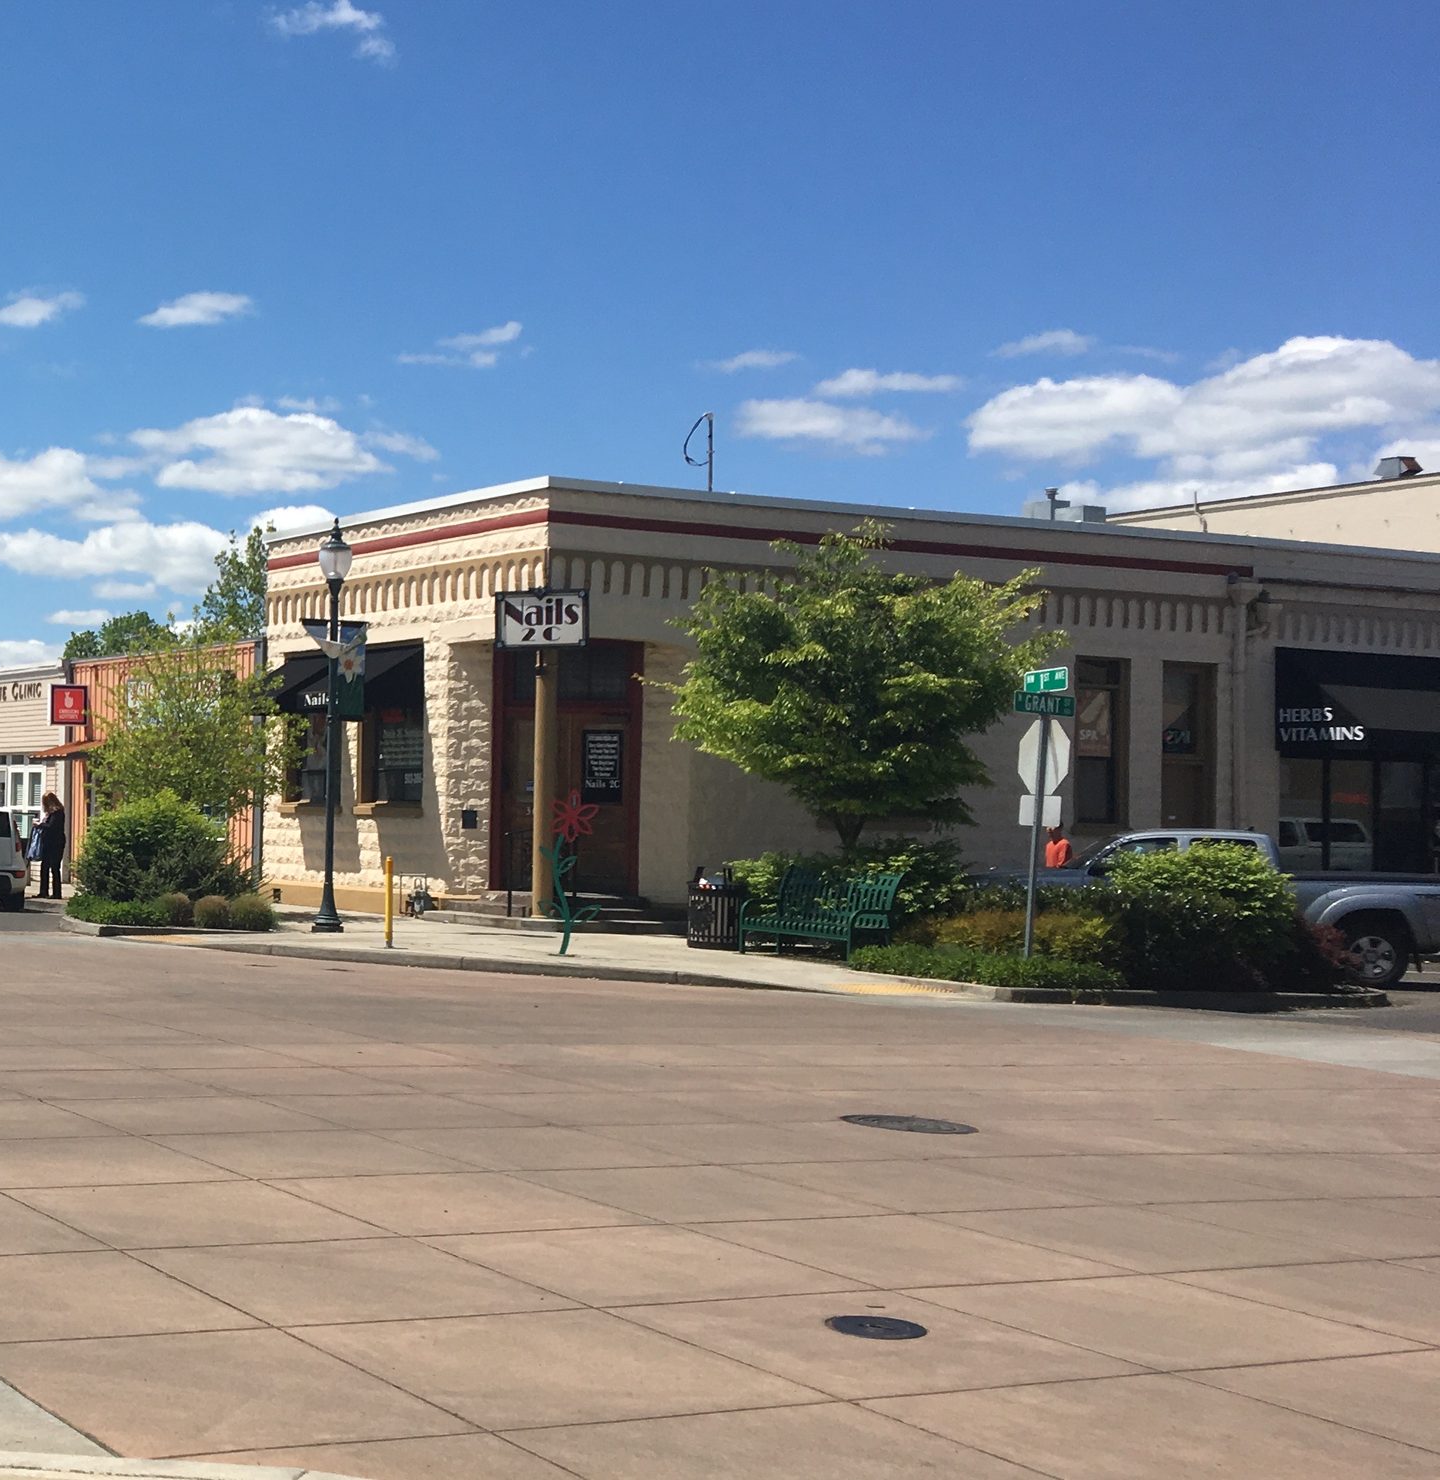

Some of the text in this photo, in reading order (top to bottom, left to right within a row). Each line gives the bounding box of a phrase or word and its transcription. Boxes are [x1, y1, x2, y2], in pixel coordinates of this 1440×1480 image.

[504, 598, 580, 626] Nails
[521, 627, 536, 642] 2
[1054, 670, 1066, 681] AVE
[11, 681, 42, 702] CLINIC
[1025, 694, 1061, 713] GRANT
[1279, 707, 1334, 723] HERBS
[1280, 725, 1365, 742] VITAMINS
